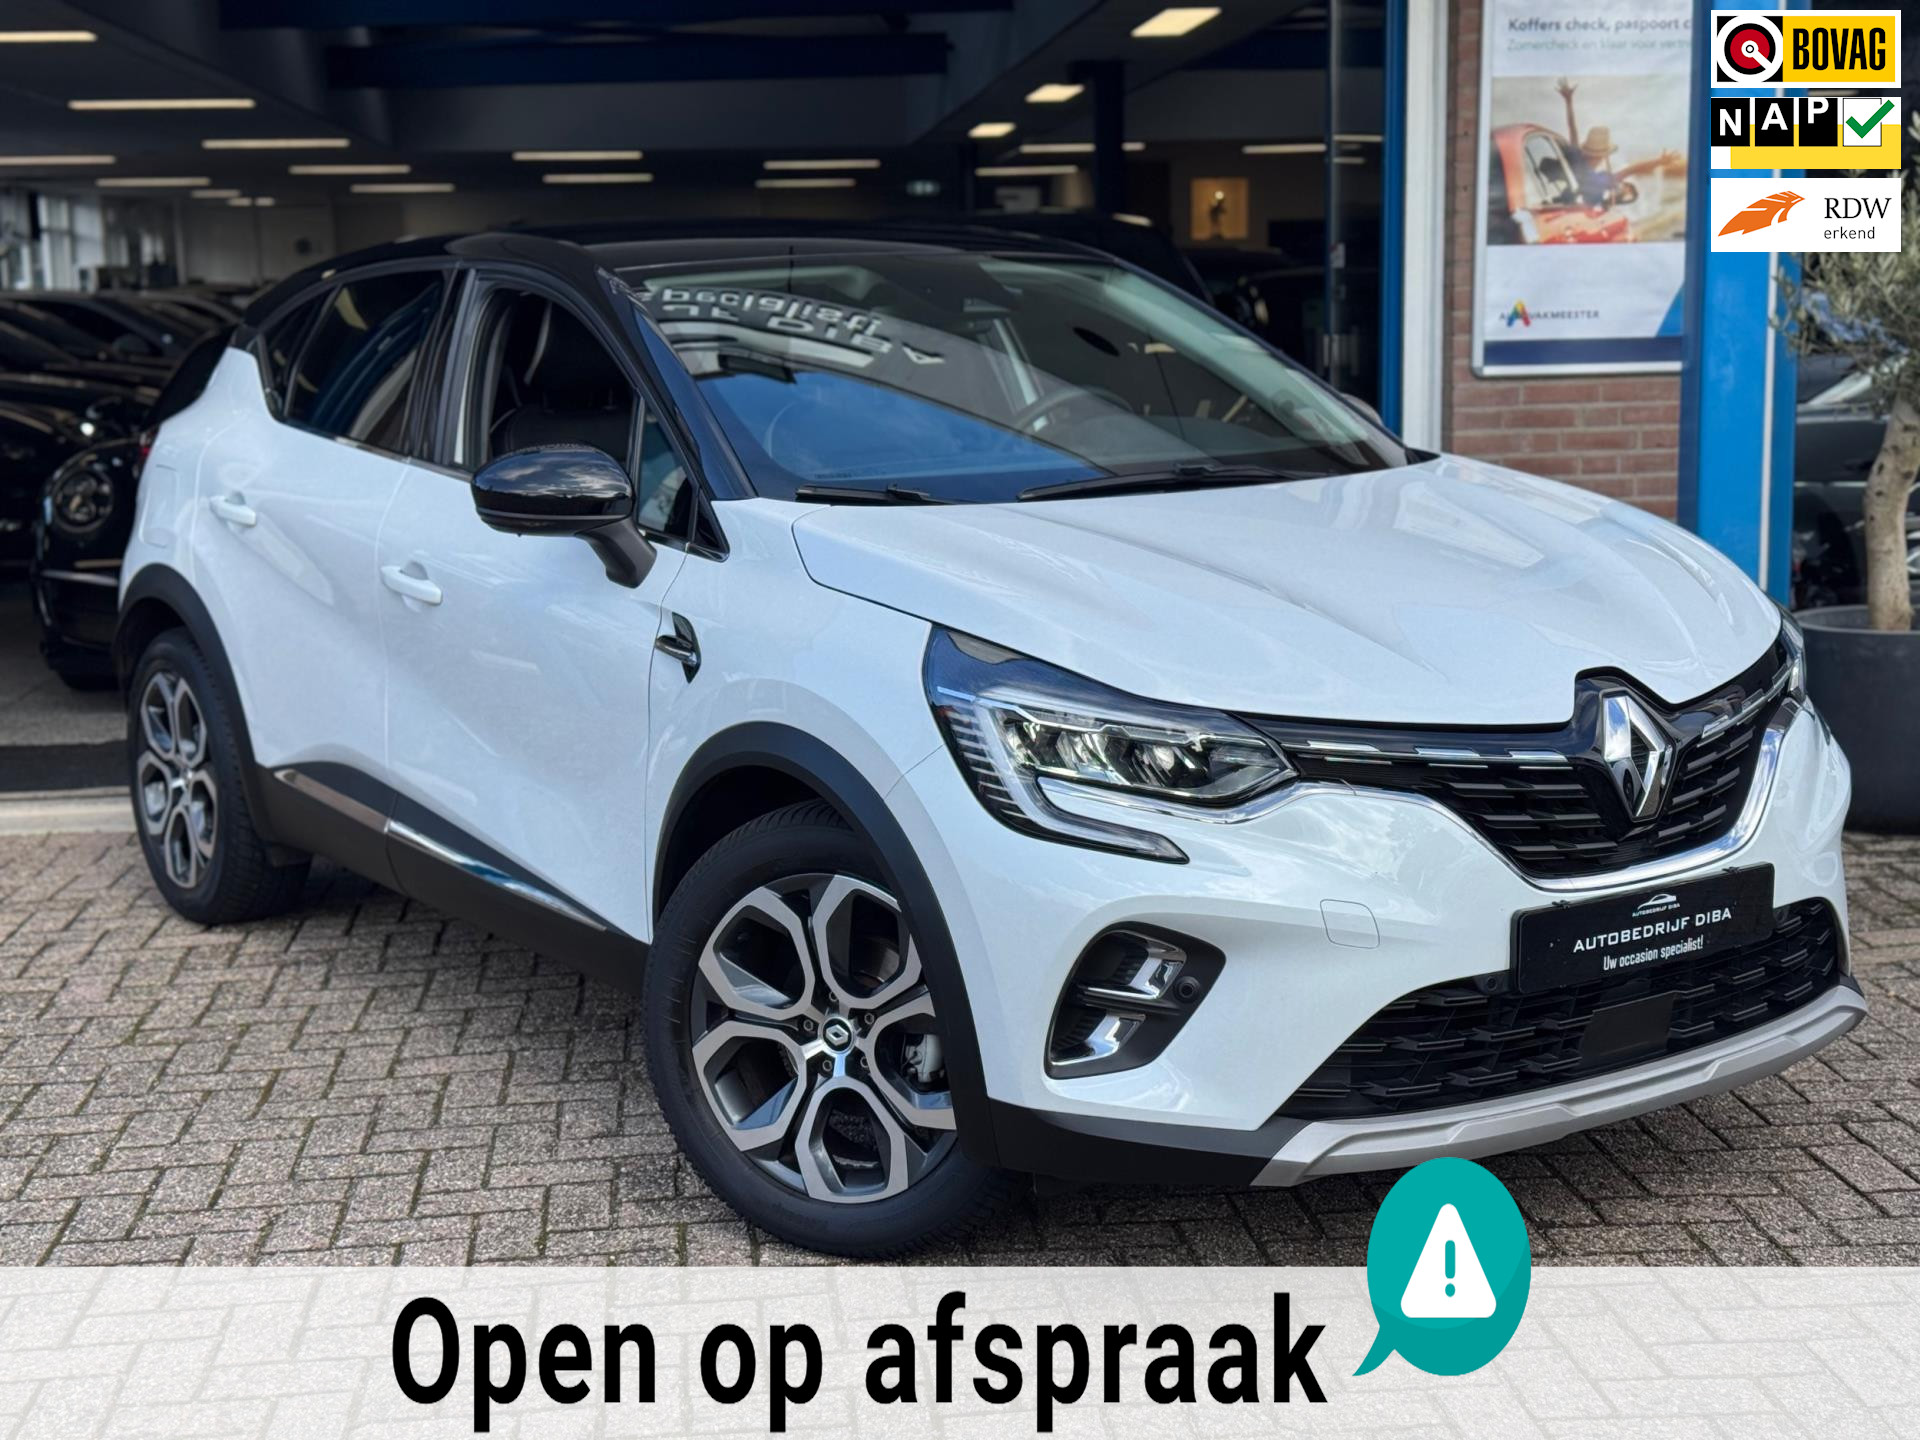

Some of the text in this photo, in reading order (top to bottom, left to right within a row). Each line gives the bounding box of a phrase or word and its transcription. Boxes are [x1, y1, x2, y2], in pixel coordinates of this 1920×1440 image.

[1508, 17, 1561, 32] Koffers
[1565, 16, 1610, 31] check,
[1615, 18, 1679, 34] paspoort
[1573, 907, 1732, 952] AUTOBEDRIJF DIBA
[1603, 934, 1704, 970] Uw occasion specialist!
